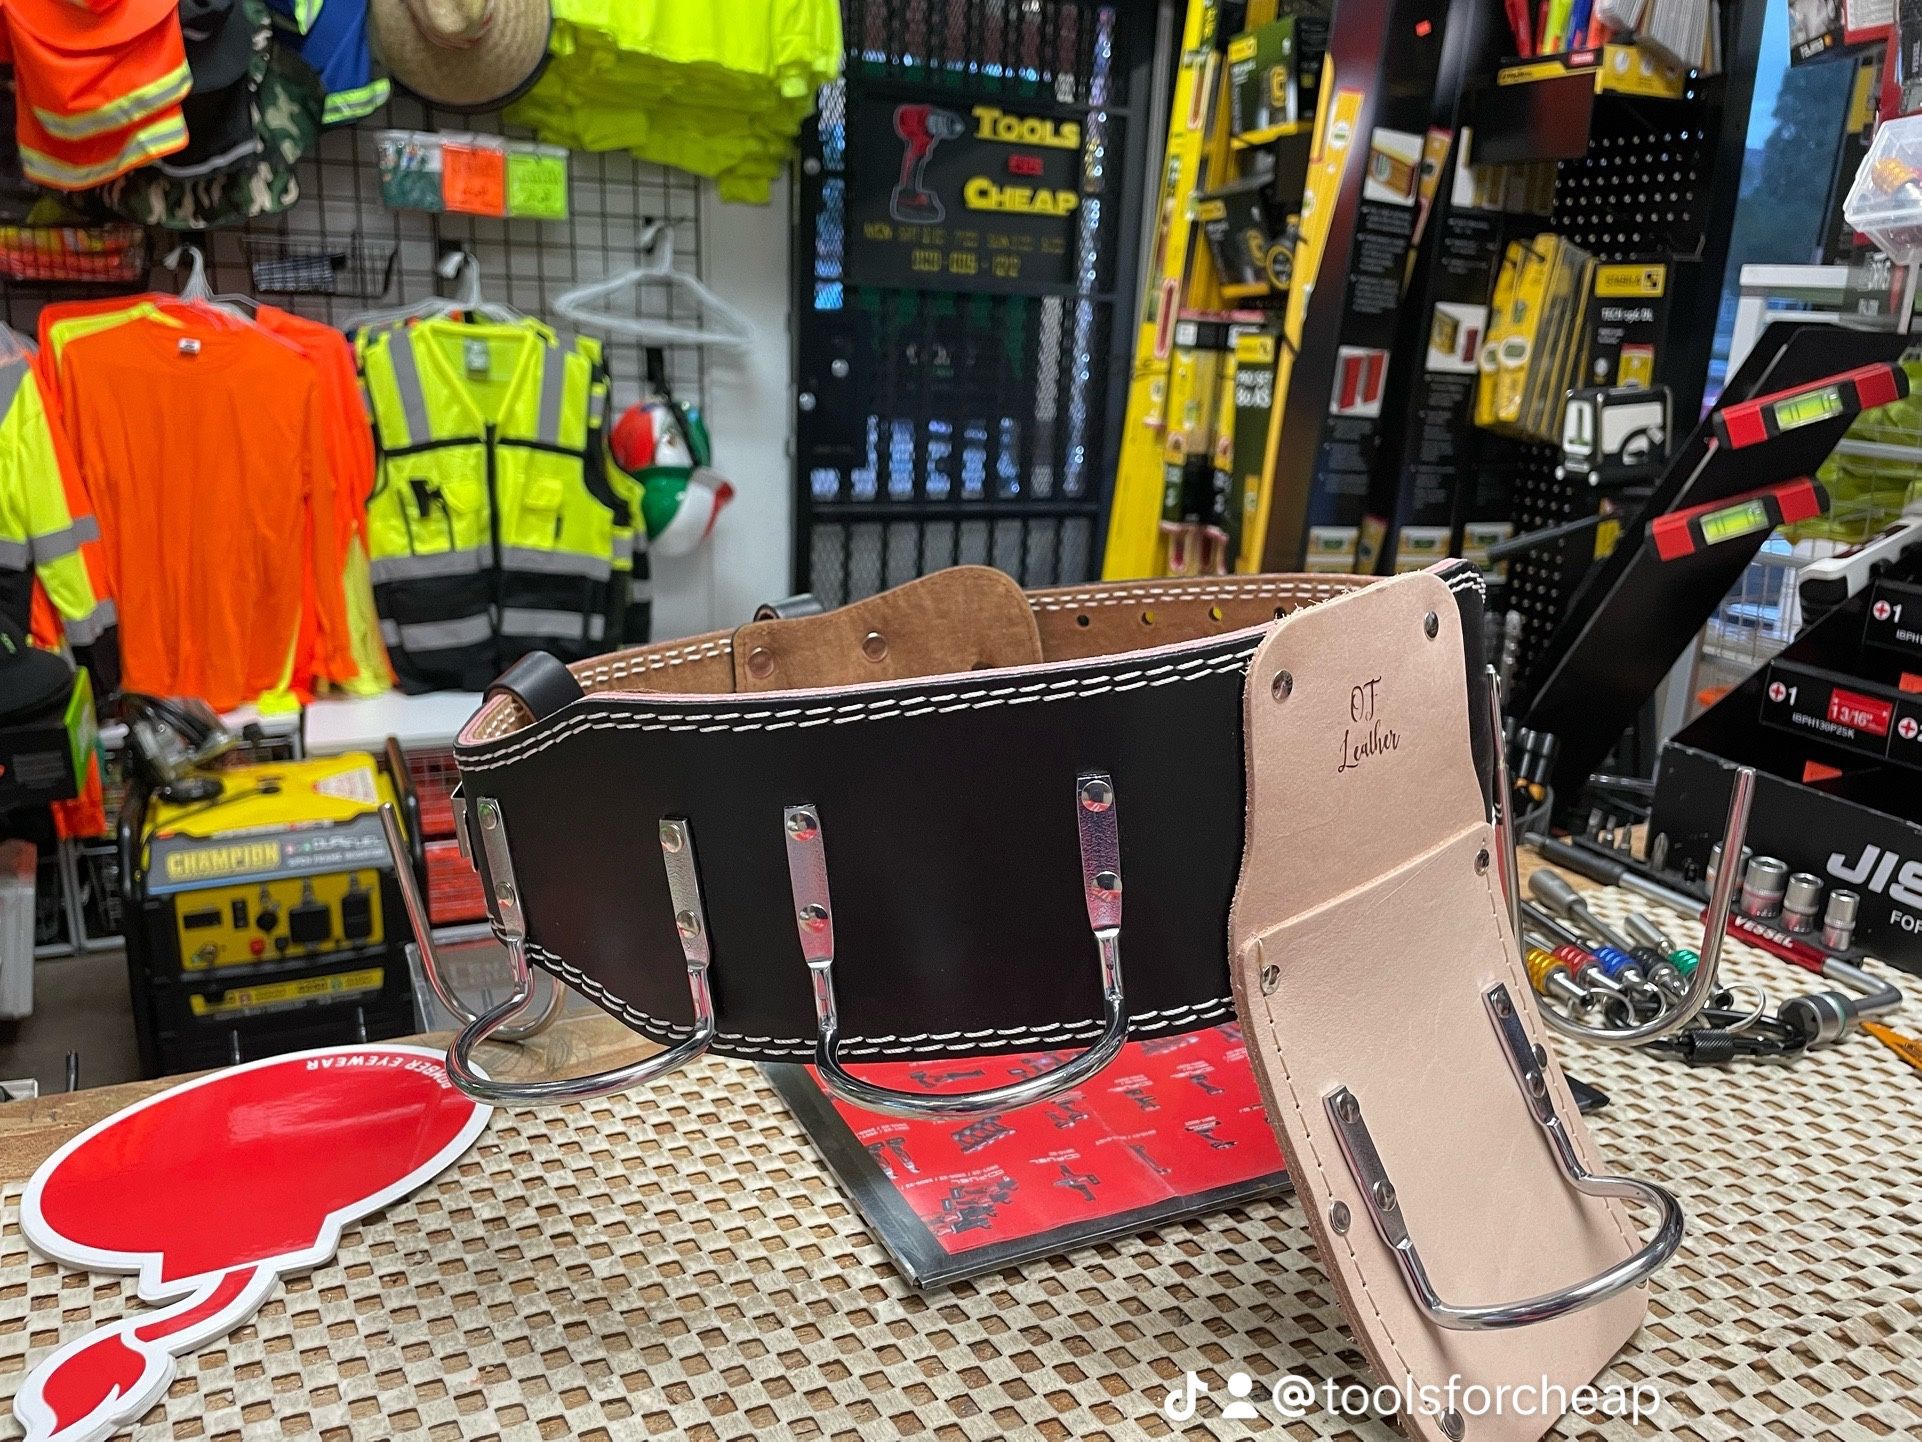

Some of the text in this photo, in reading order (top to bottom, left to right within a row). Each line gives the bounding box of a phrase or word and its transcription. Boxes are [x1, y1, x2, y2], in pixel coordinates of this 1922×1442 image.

[1892, 603, 1903, 624] 1
[1788, 686, 1798, 706] 1
[1338, 719, 1400, 773] Leather
[166, 840, 282, 882] CHAMPION
[1734, 914, 1794, 948] VESSEL
[305, 1055, 403, 1071] EYEWEAR
